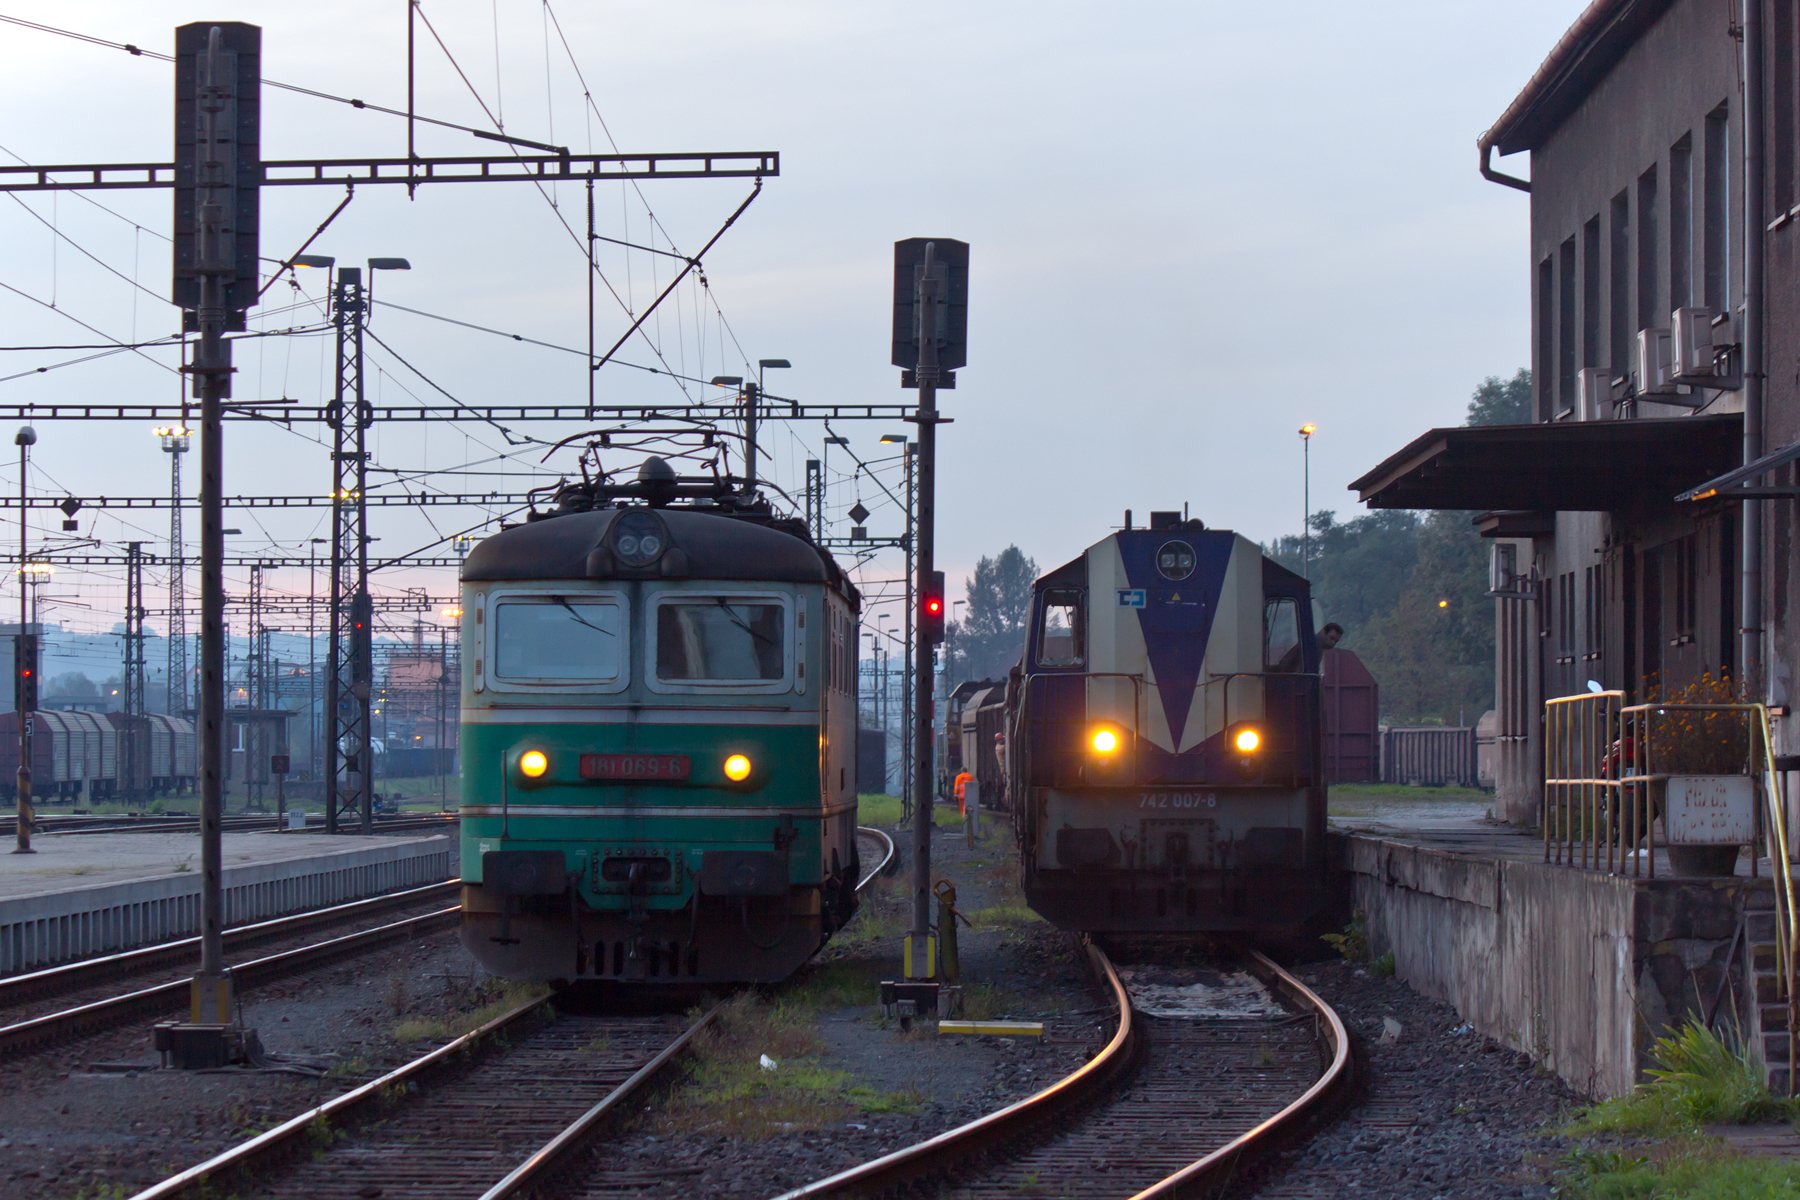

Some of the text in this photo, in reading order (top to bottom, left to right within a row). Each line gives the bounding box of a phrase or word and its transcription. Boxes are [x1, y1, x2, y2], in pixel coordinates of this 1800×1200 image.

[589, 757, 681, 776] 181 069-6
[1140, 792, 1217, 808] 742 007-8
